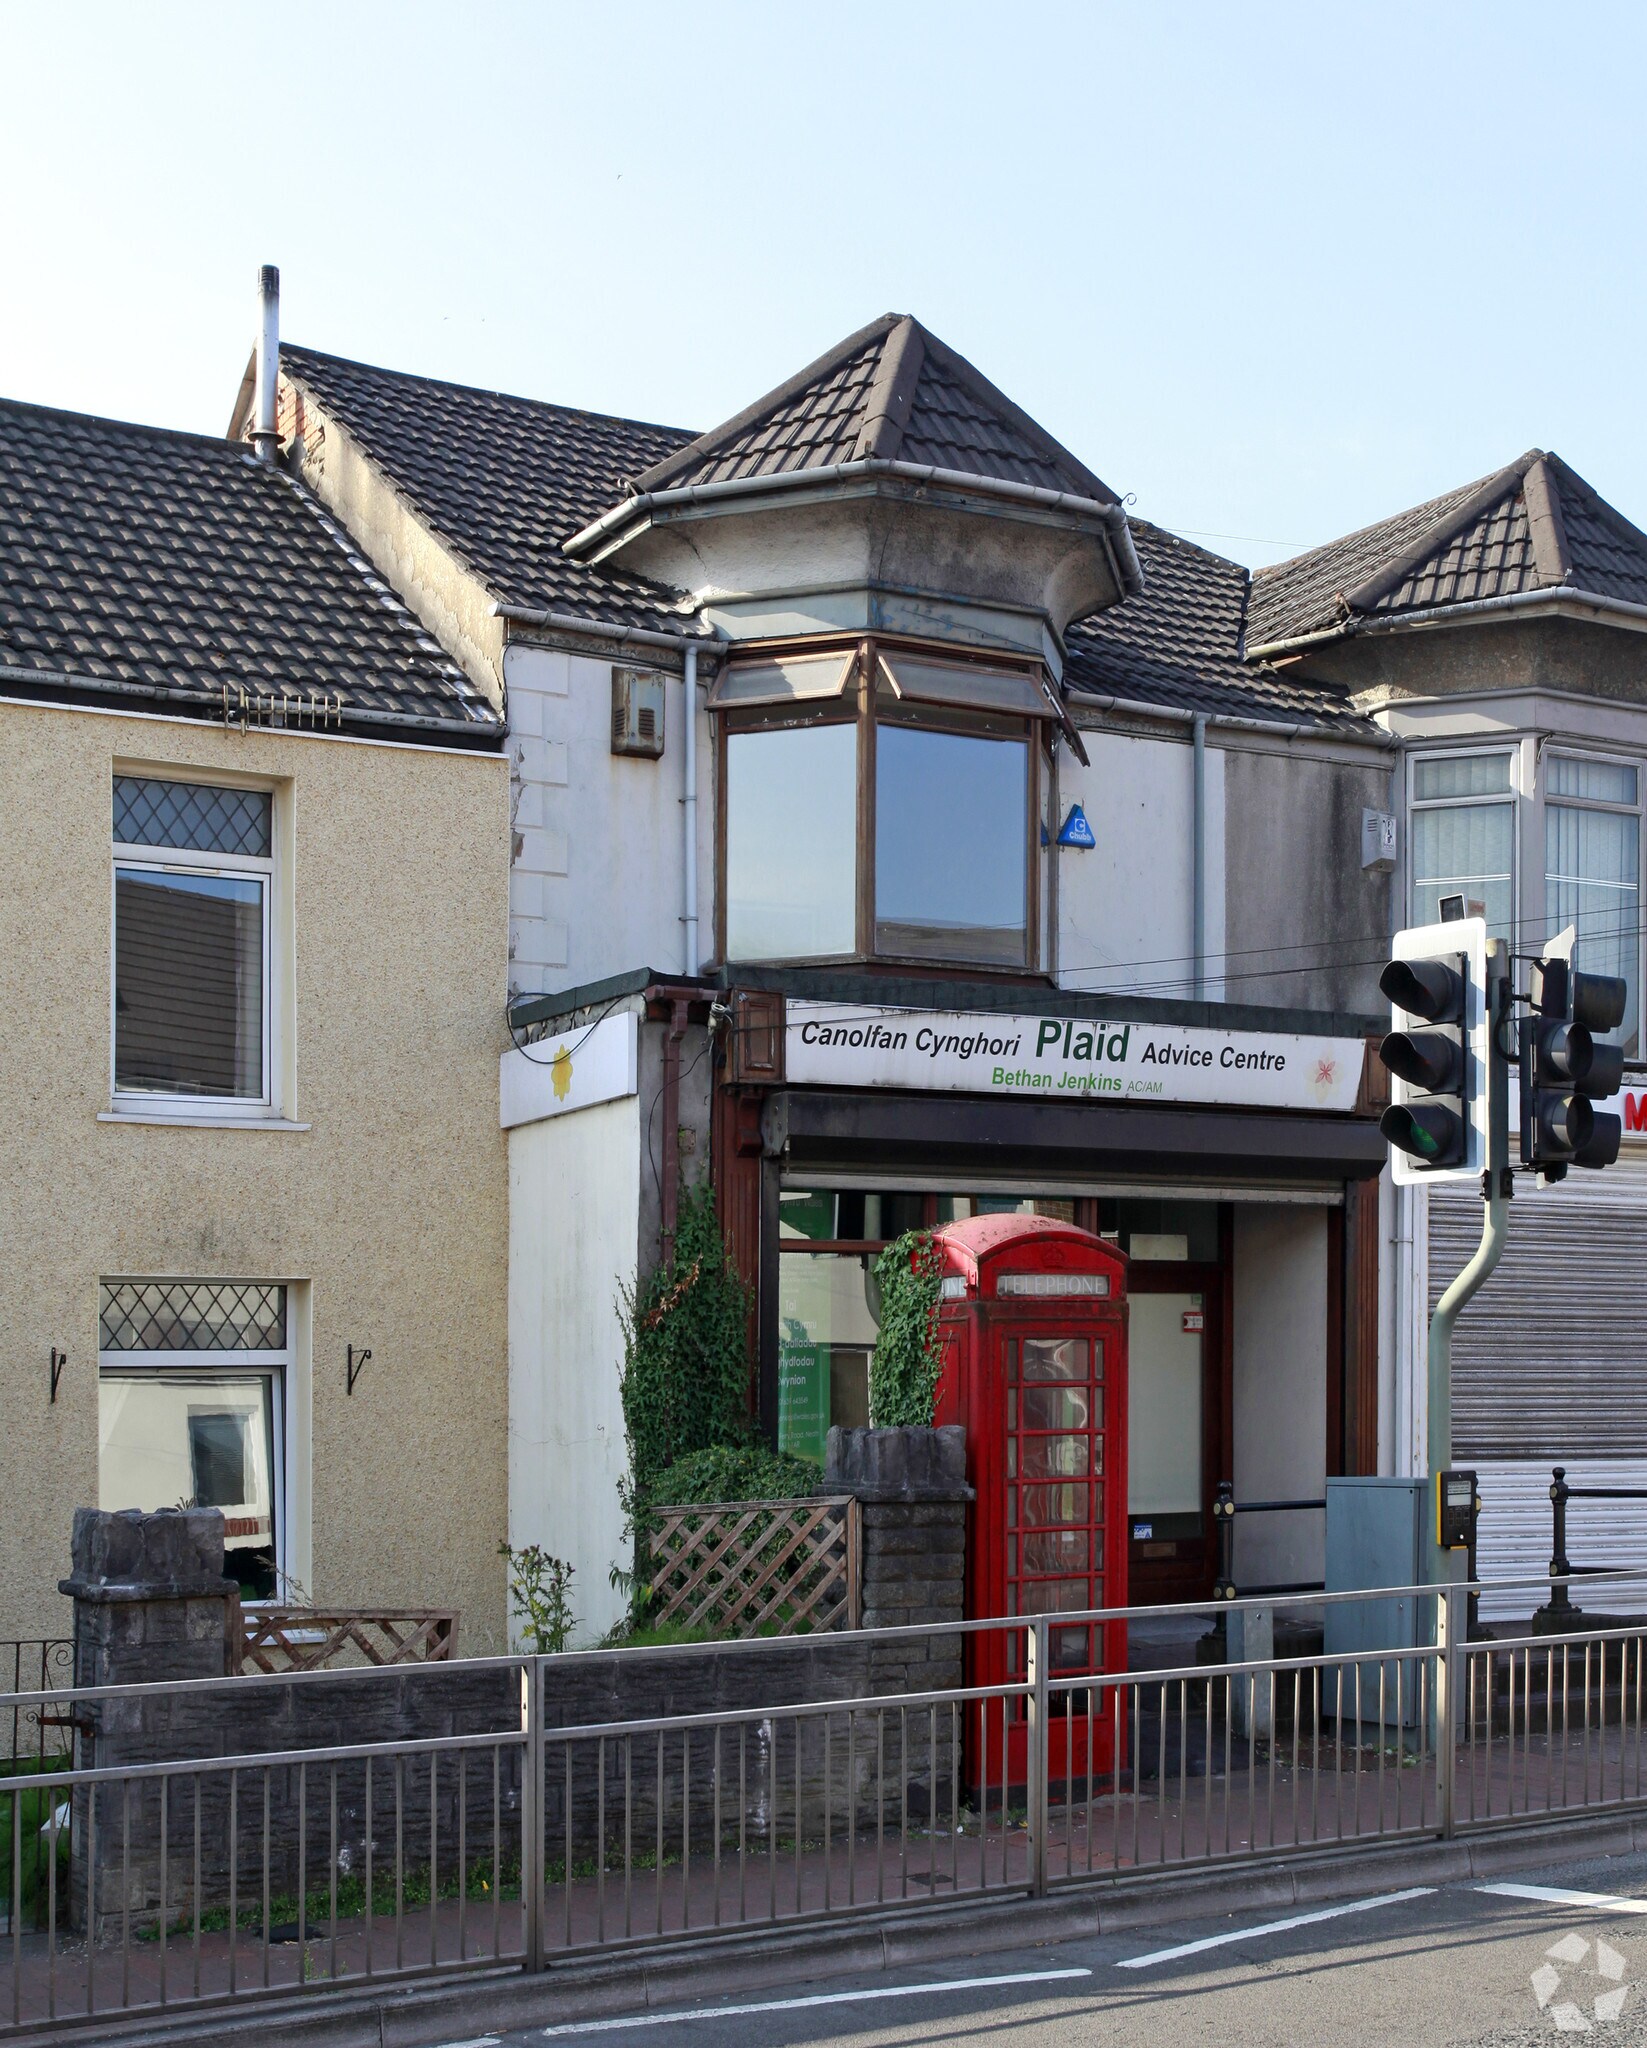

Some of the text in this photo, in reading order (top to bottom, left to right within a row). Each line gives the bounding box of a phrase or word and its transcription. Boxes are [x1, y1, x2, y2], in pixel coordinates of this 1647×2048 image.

[1069, 831, 1092, 841] Chubb
[801, 1019, 1286, 1071] Canolfan Cynghori Plaid Advice Centre
[992, 1067, 1163, 1094] Bethan Jenkins AC/AM
[1003, 1275, 1105, 1295] TELEPHONE
